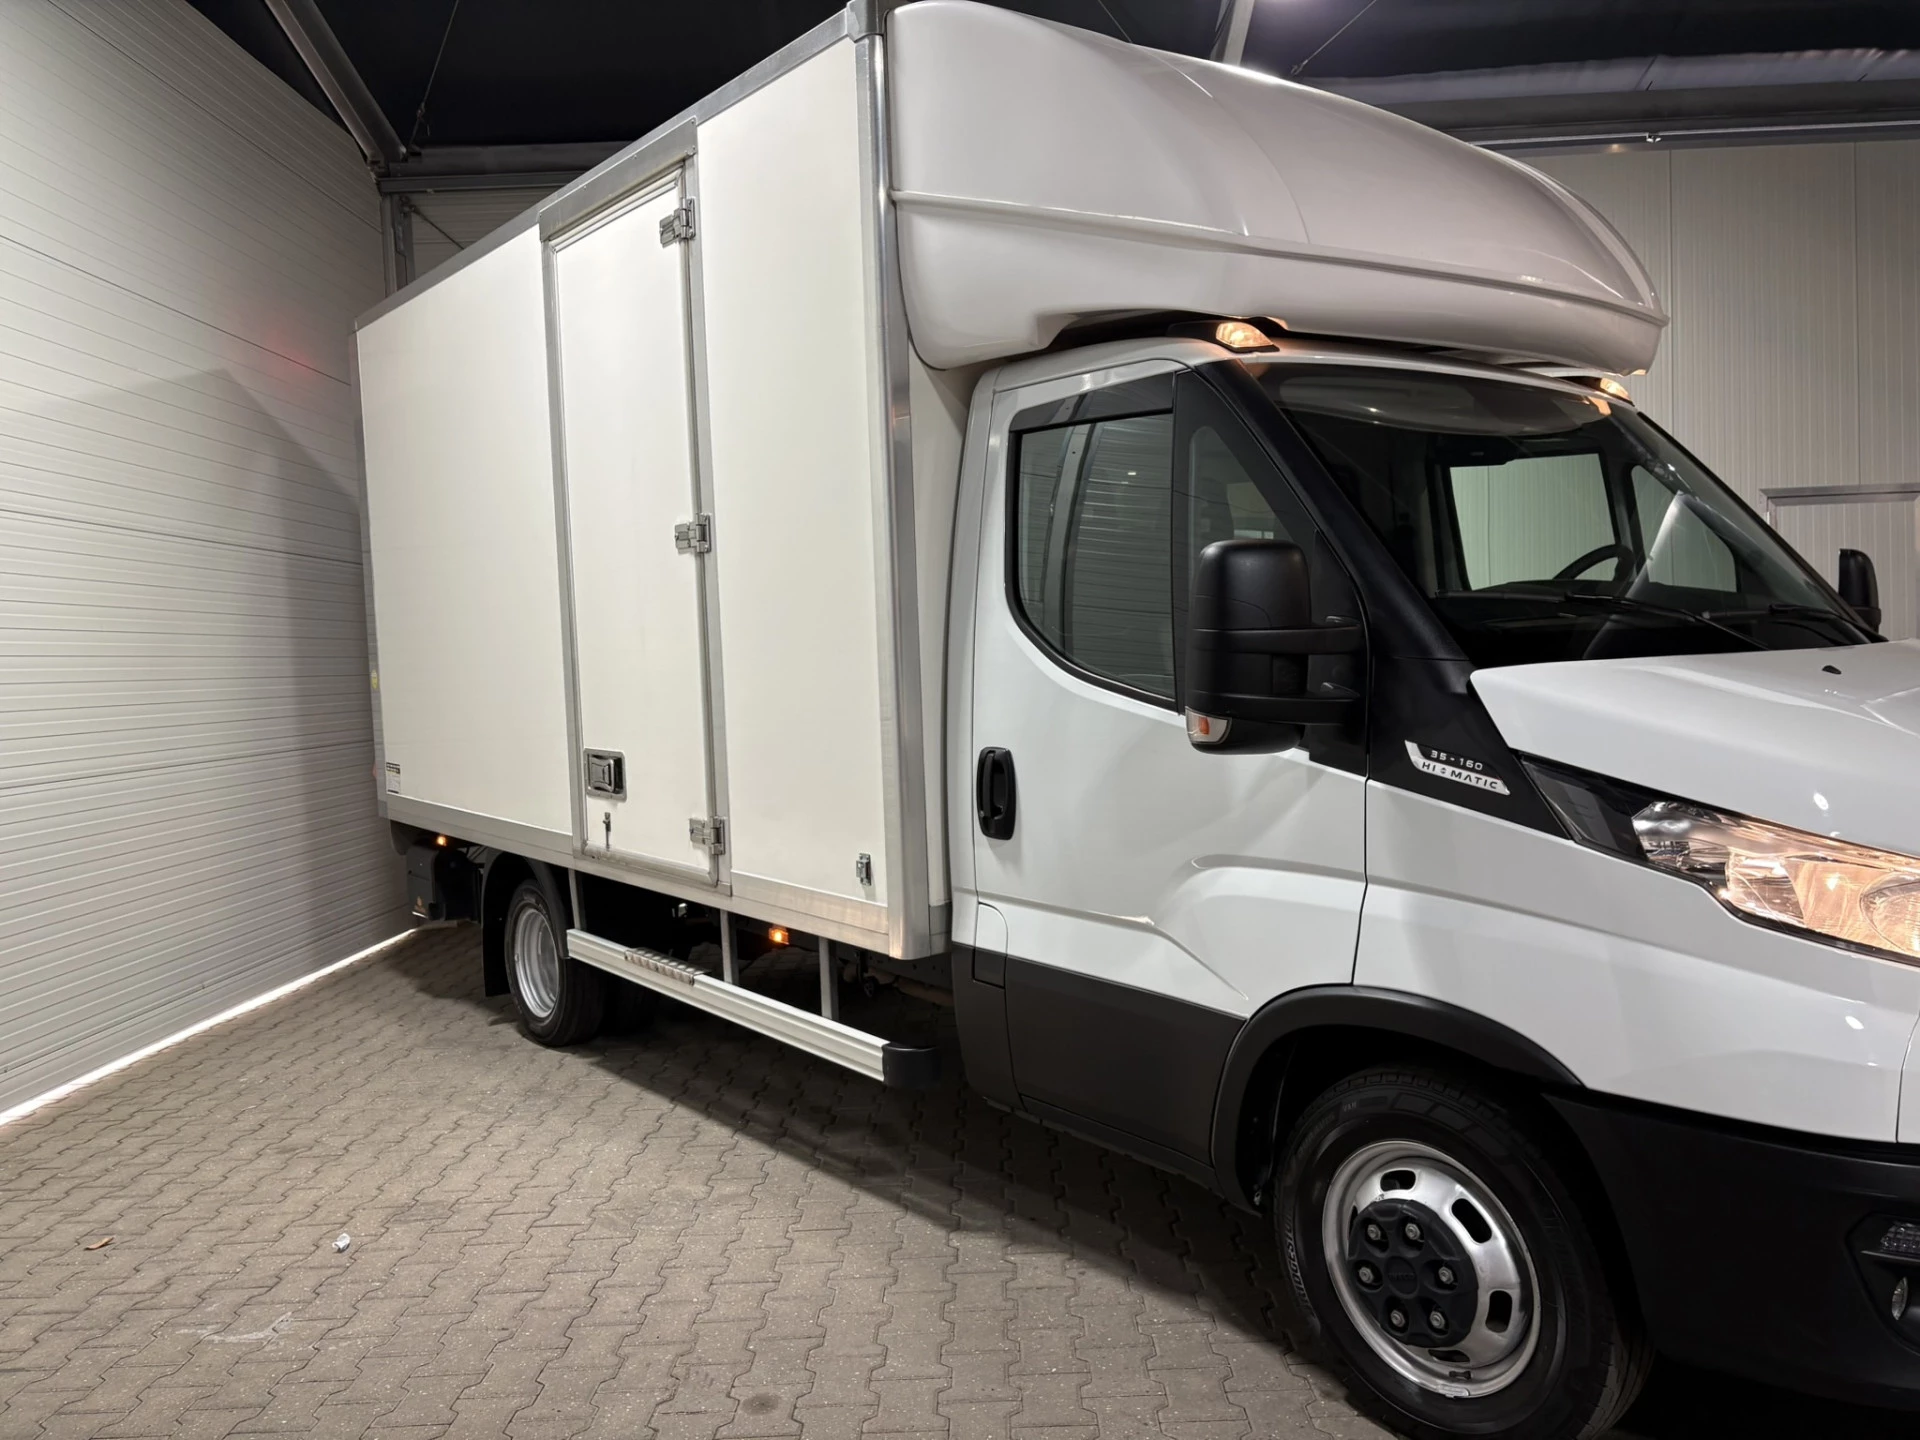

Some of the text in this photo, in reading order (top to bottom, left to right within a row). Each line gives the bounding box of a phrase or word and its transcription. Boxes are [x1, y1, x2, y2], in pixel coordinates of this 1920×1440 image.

[1430, 750, 1447, 761] 35
[1459, 758, 1484, 771] 160
[1450, 770, 1498, 790] MATIC
